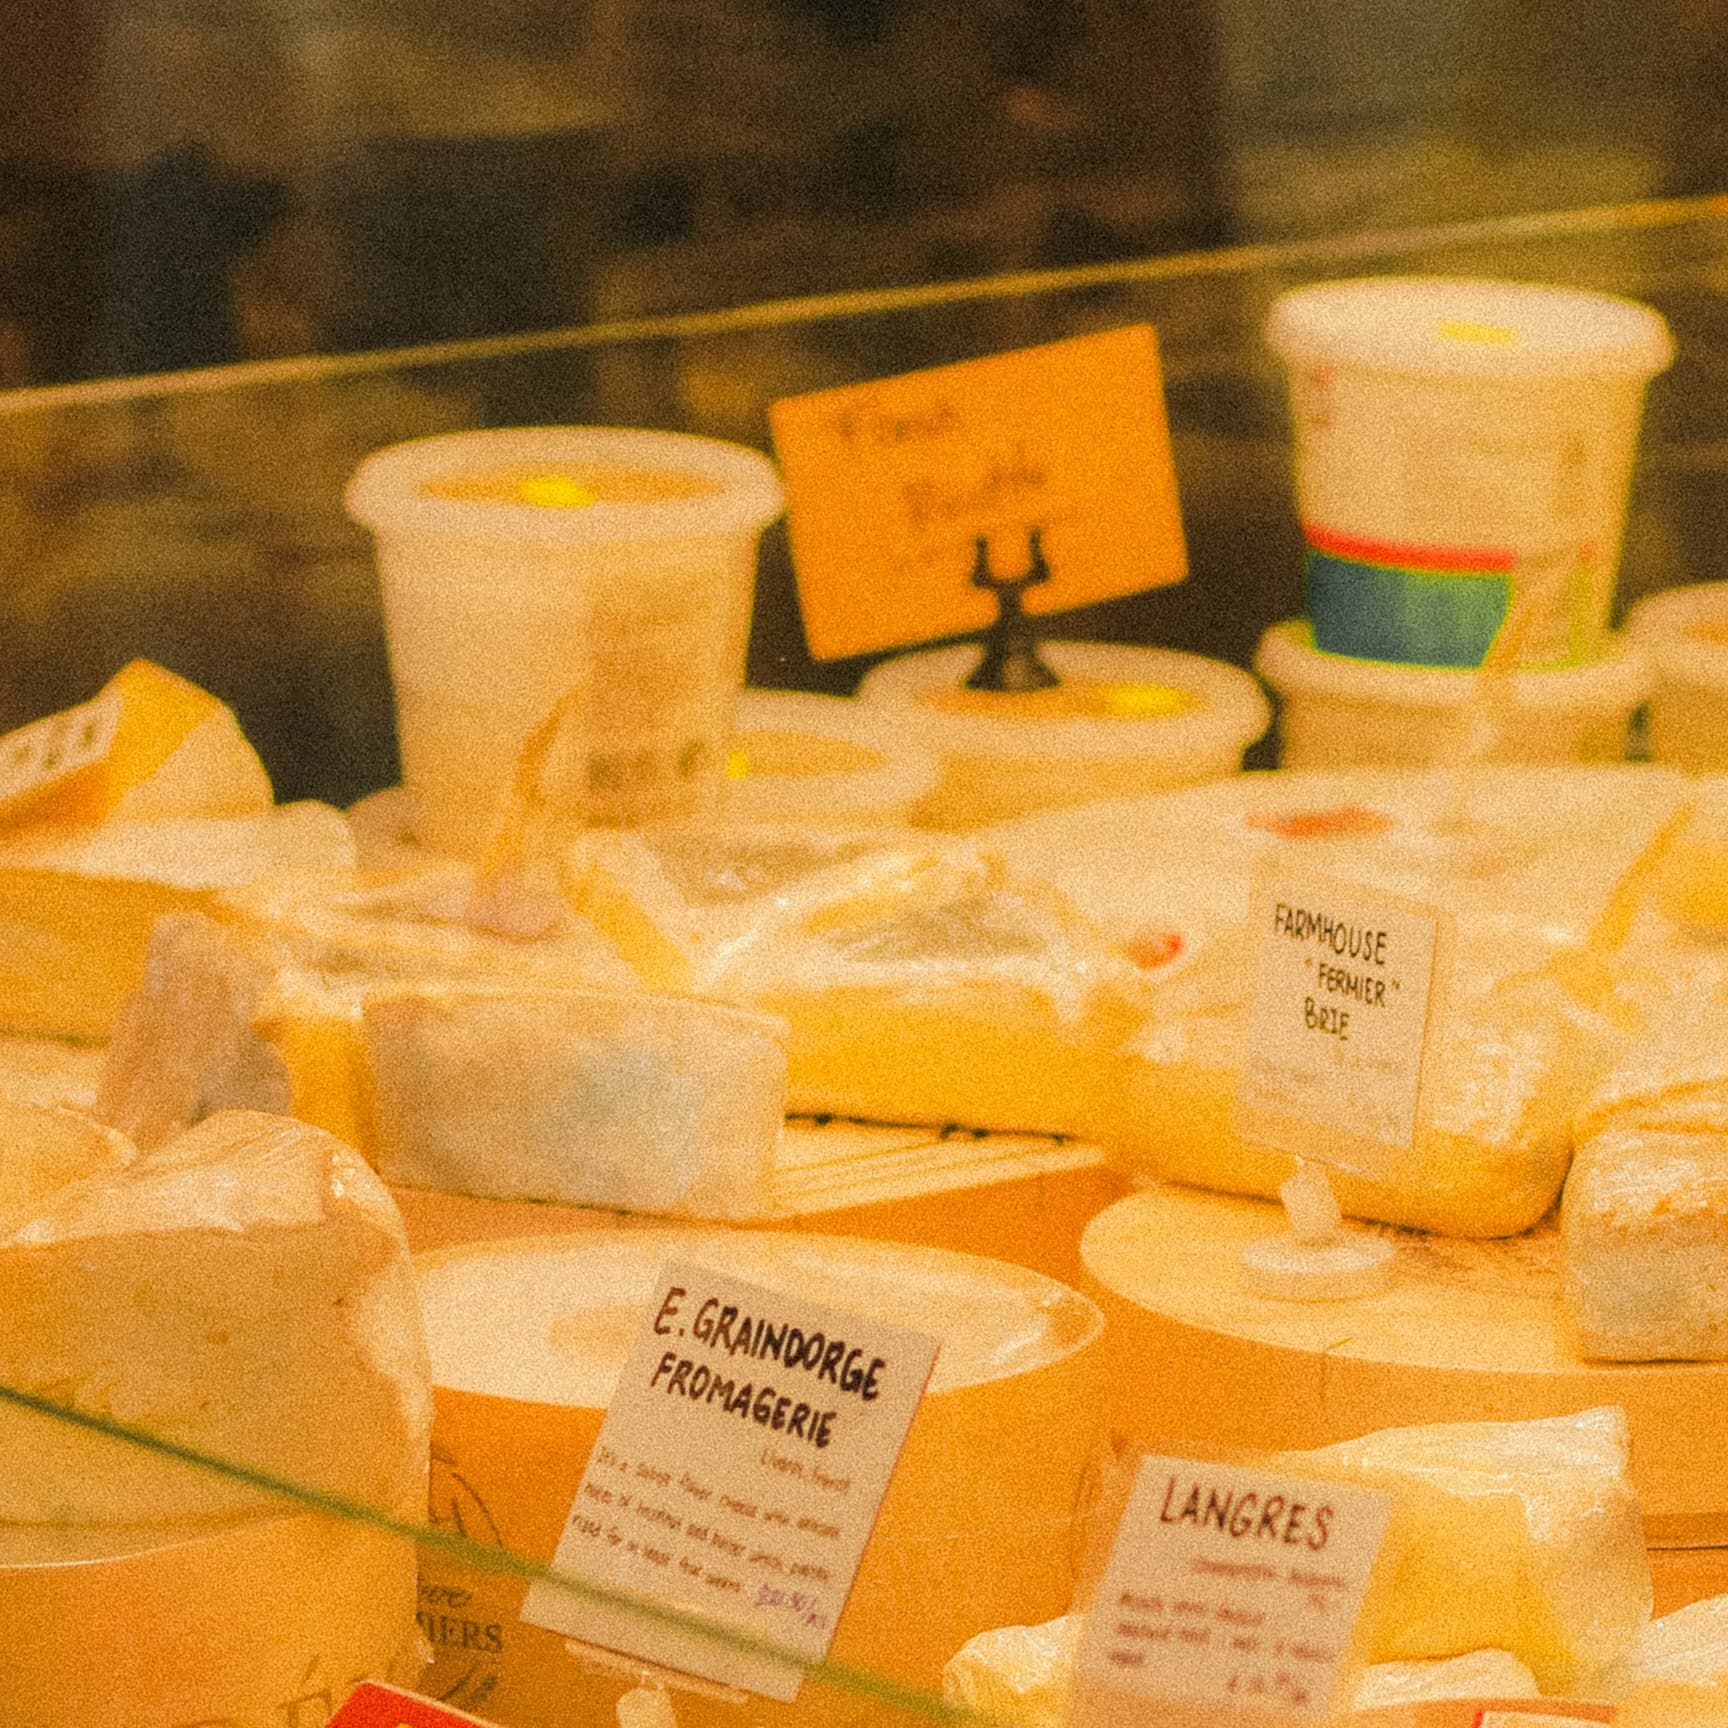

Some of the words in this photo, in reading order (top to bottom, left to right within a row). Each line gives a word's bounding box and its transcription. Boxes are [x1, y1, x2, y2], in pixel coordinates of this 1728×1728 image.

[1273, 902, 1388, 966] FARMHOUSE
[1304, 995, 1350, 1041] BRIE
[649, 1351, 838, 1450] FROMAGERIE
[1159, 1473, 1335, 1552] LANGRES
